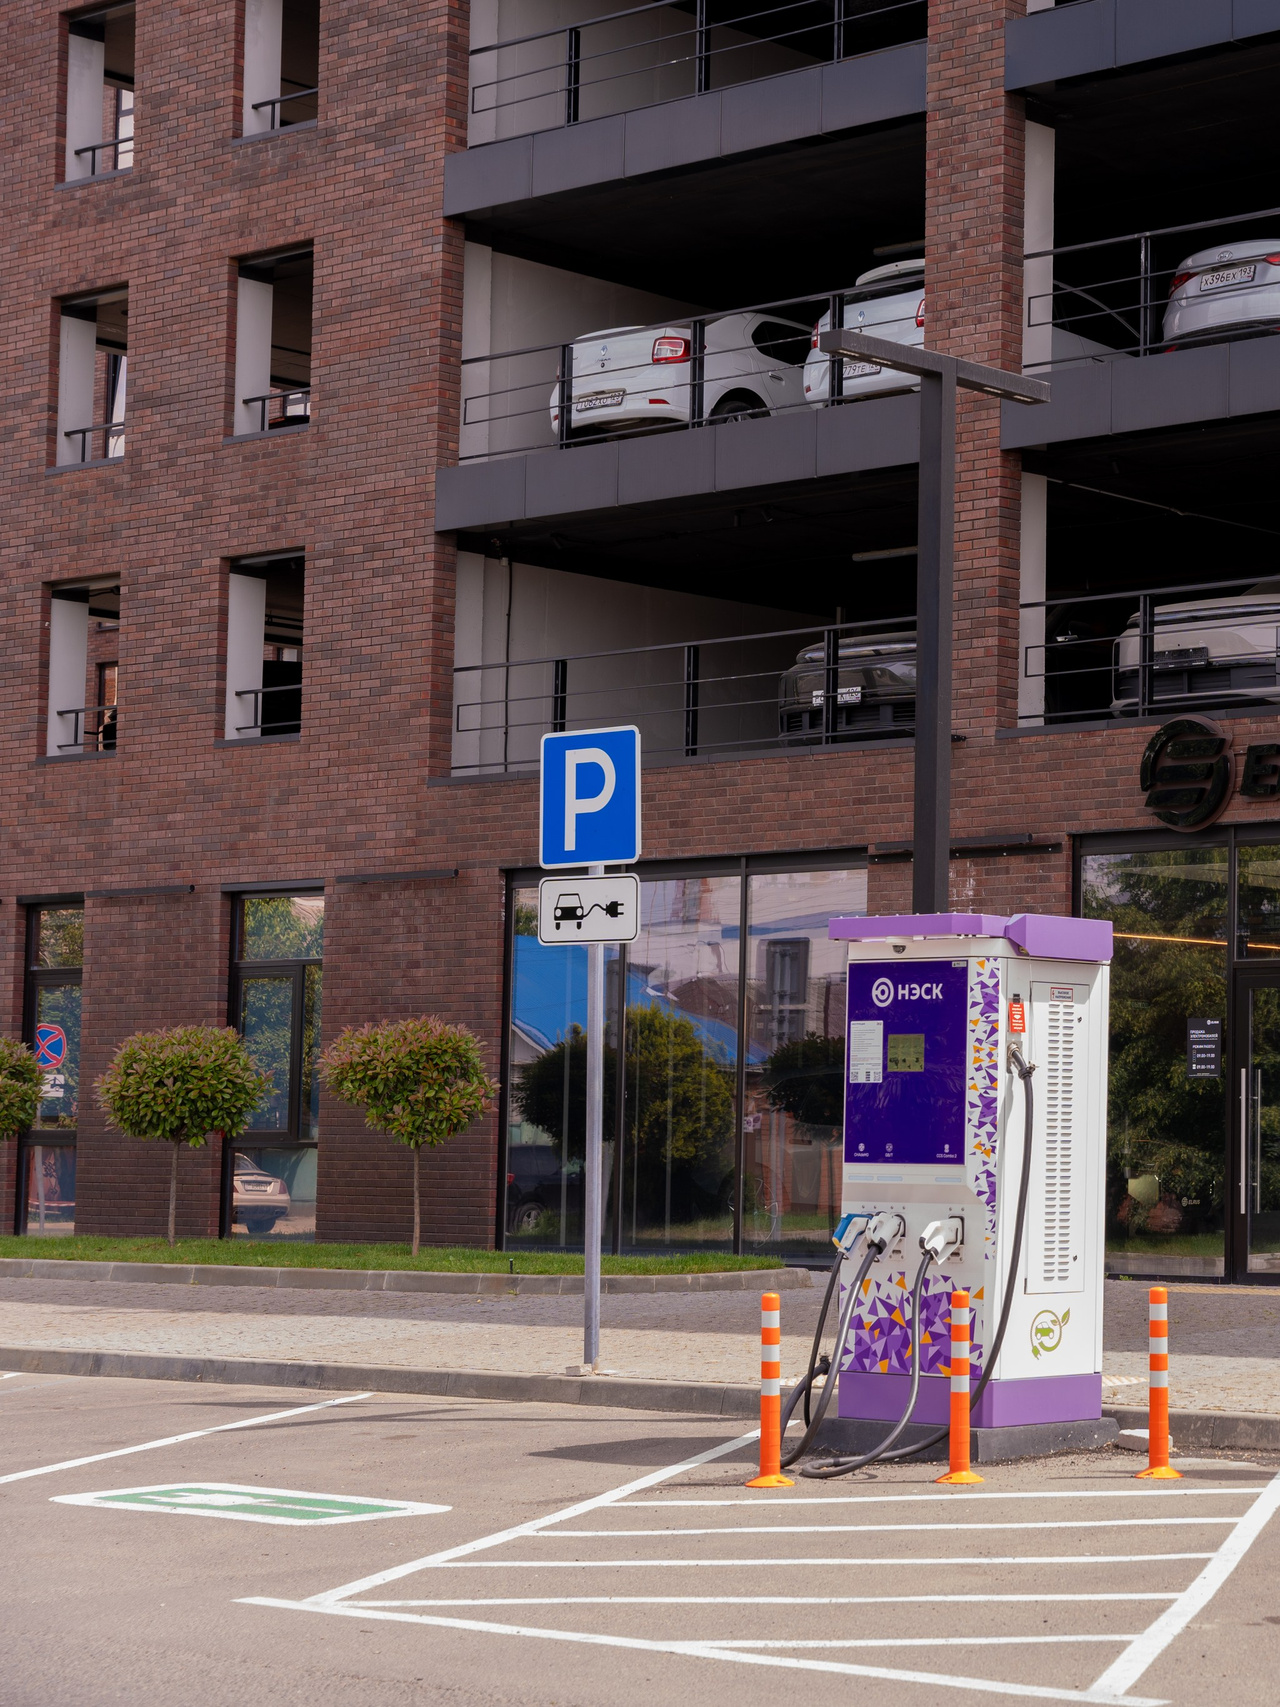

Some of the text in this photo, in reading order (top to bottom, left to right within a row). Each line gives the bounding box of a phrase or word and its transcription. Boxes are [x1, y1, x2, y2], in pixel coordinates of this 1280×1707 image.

[1203, 266, 1252, 287] Х396ЕХ 193
[565, 748, 616, 851] P
[898, 983, 943, 1000] НЭСК
